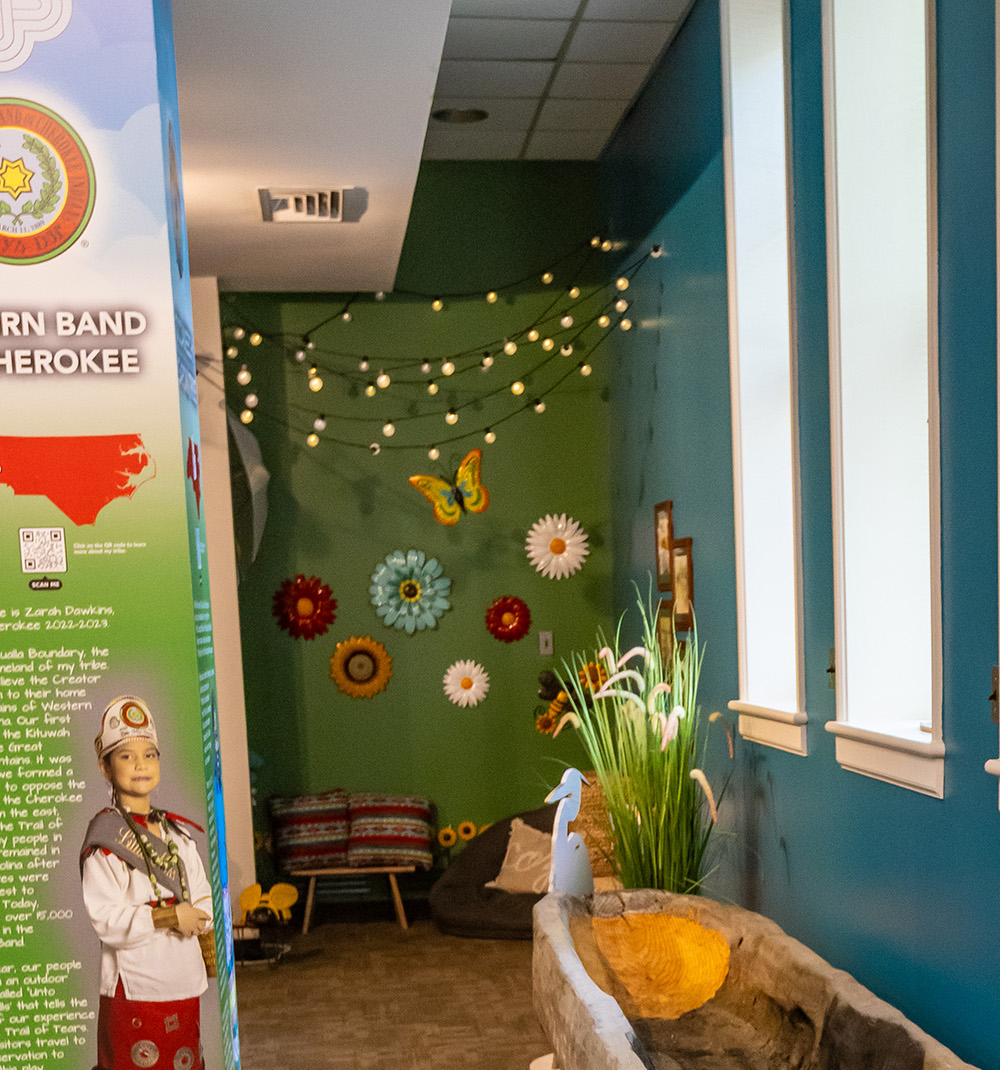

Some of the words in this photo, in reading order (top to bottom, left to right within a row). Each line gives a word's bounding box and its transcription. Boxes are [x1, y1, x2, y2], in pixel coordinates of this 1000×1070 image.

[1, 311, 46, 337] RN
[56, 311, 147, 336] BAND
[11, 607, 20, 617] is
[25, 606, 61, 617] Zarah
[65, 604, 115, 616] Dawkins,
[28, 646, 86, 662] Boundary,
[91, 646, 110, 657] the
[38, 659, 53, 672] of
[57, 663, 75, 675] my
[30, 675, 48, 685] the
[52, 674, 101, 685] Creator
[8, 689, 20, 699] to
[25, 688, 52, 699] their
[56, 687, 86, 698] home
[22, 700, 37, 713] of
[41, 700, 93, 711] Western
[16, 715, 39, 725] Our
[44, 713, 71, 725] first
[3, 729, 21, 740] the
[25, 727, 71, 739] Kituwah
[8, 740, 42, 752] Great
[36, 754, 44, 764] It
[49, 755, 72, 764] was
[18, 766, 63, 777] formed
[66, 768, 73, 776] a
[5, 782, 18, 793] to
[22, 780, 63, 796] oppose
[68, 779, 86, 790] the
[3, 795, 21, 806] the
[25, 791, 83, 805] Cherokee
[10, 808, 28, 818] the
[18, 820, 44, 832] Trail
[48, 817, 63, 830] of
[12, 832, 49, 847] people
[53, 833, 62, 842] in
[51, 845, 61, 855] in
[27, 857, 60, 869] after
[19, 873, 49, 883] were
[22, 884, 34, 896] to
[2, 897, 40, 912] Today,
[5, 913, 32, 922] over
[36, 908, 74, 920] 15,000
[3, 925, 12, 934] in
[16, 924, 34, 934] the
[21, 963, 42, 973] our
[46, 960, 82, 976] people
[5, 976, 19, 986] an
[23, 973, 69, 985] outdoor
[17, 1000, 39, 1011] that
[44, 998, 66, 1009] tells
[70, 997, 88, 1008] the
[9, 1015, 30, 1025] our
[33, 1011, 96, 1025] experience
[5, 1026, 31, 1037] Trail
[34, 1022, 49, 1034] of
[36, 1036, 70, 1048] travel
[73, 1035, 86, 1045] to
[0, 1050, 48, 1063] ervation
[52, 1049, 65, 1059] to
